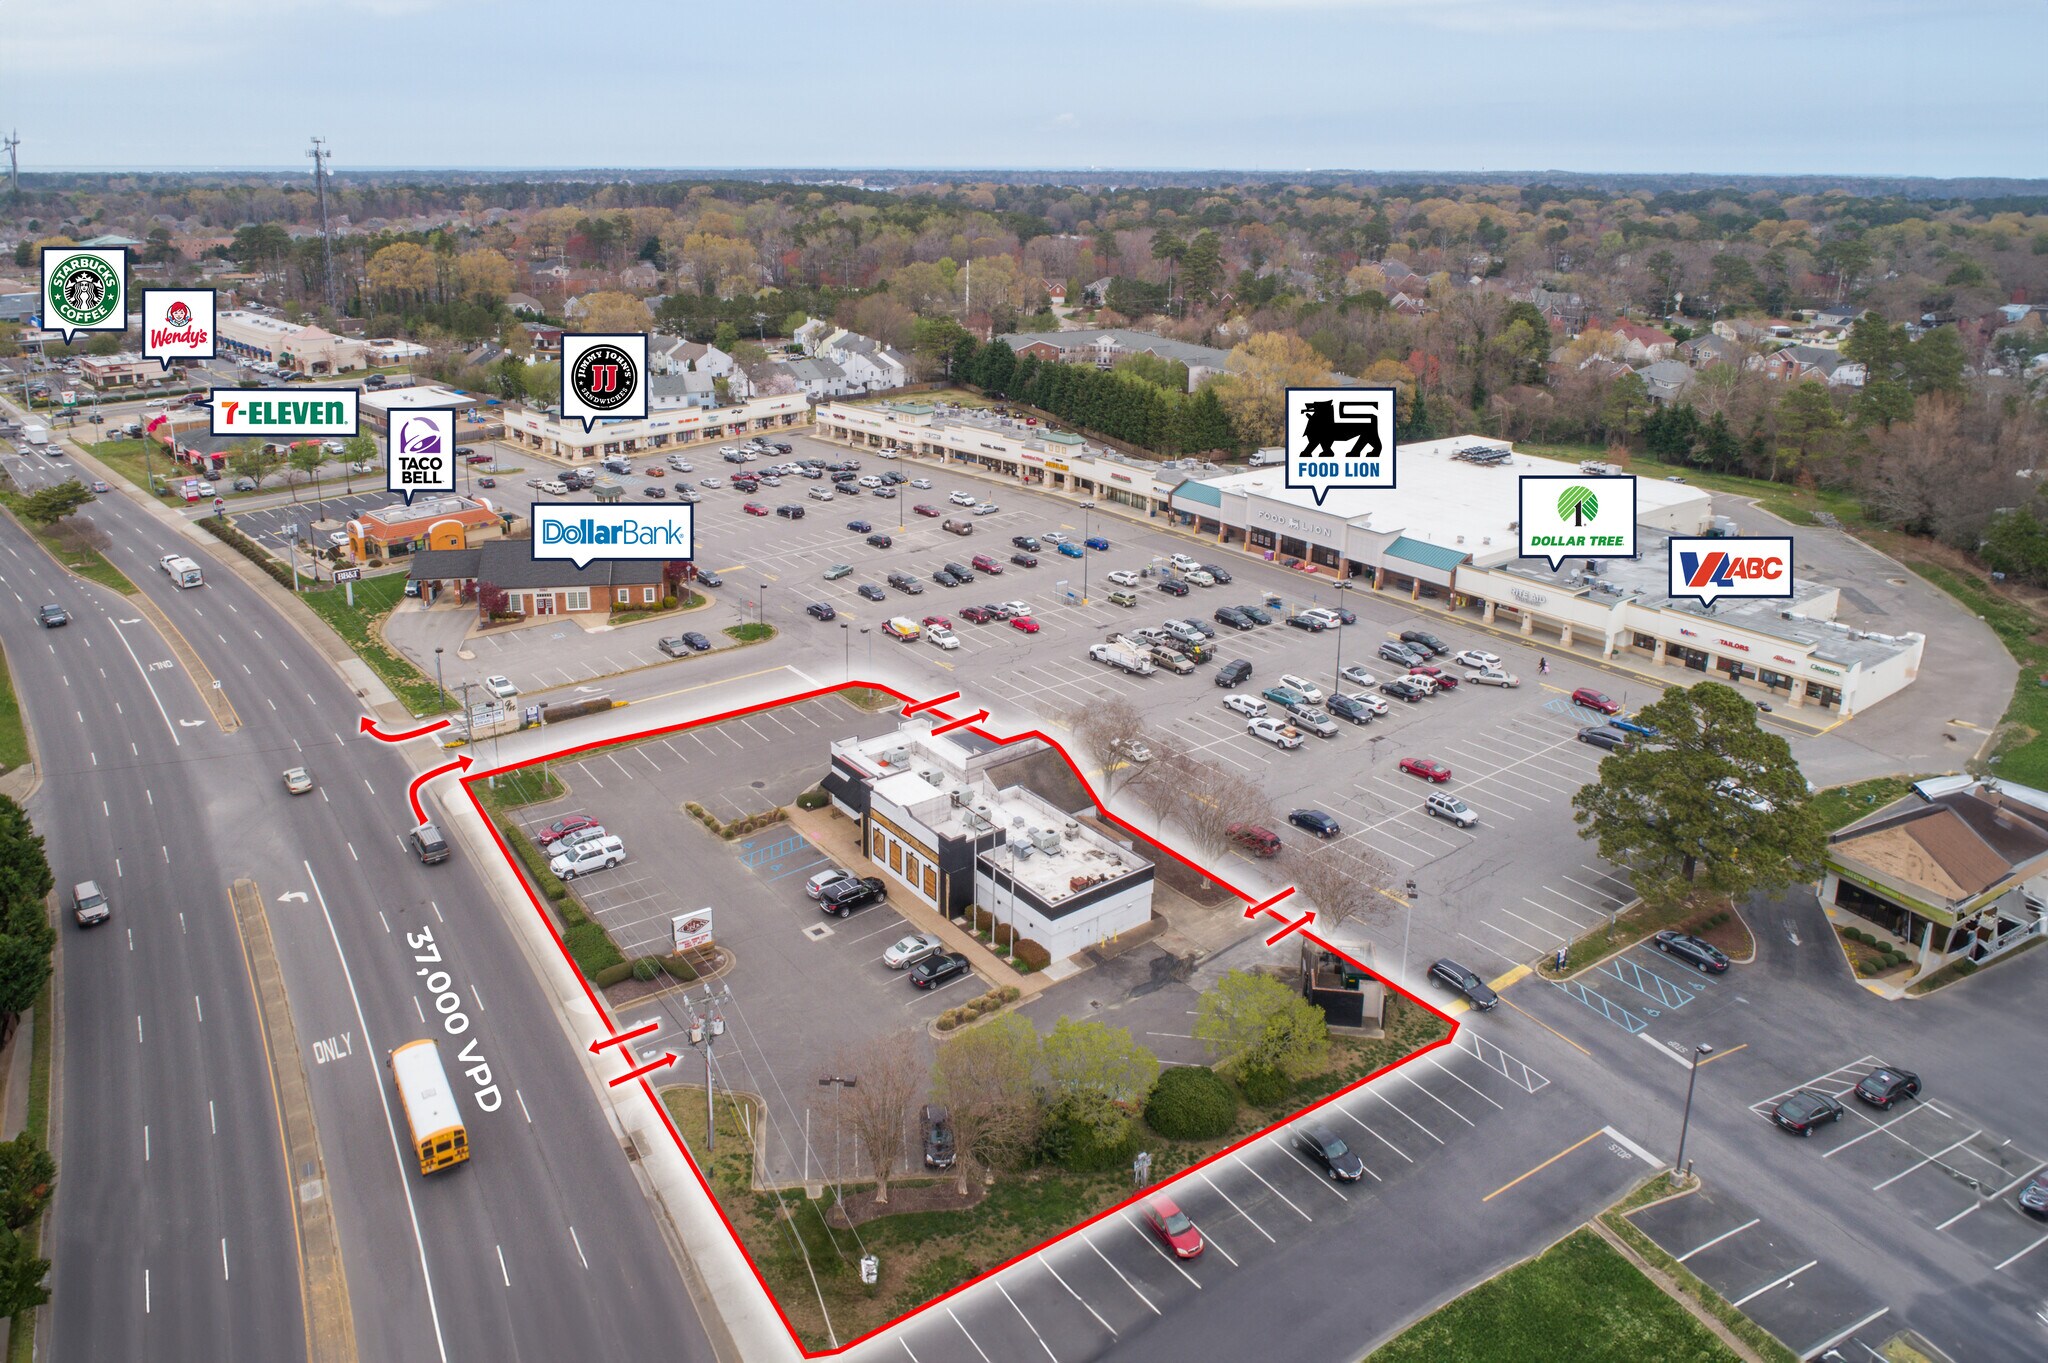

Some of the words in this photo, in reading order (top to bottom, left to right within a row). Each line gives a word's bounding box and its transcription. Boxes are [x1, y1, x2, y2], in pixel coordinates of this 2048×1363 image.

[1258, 510, 1286, 524] FOOD
[1302, 522, 1332, 537] LION
[1720, 639, 1749, 651] TAILORS
[149, 660, 174, 672] ONLY
[1810, 663, 1840, 677] Cleaners
[313, 1031, 352, 1064] ONLY
